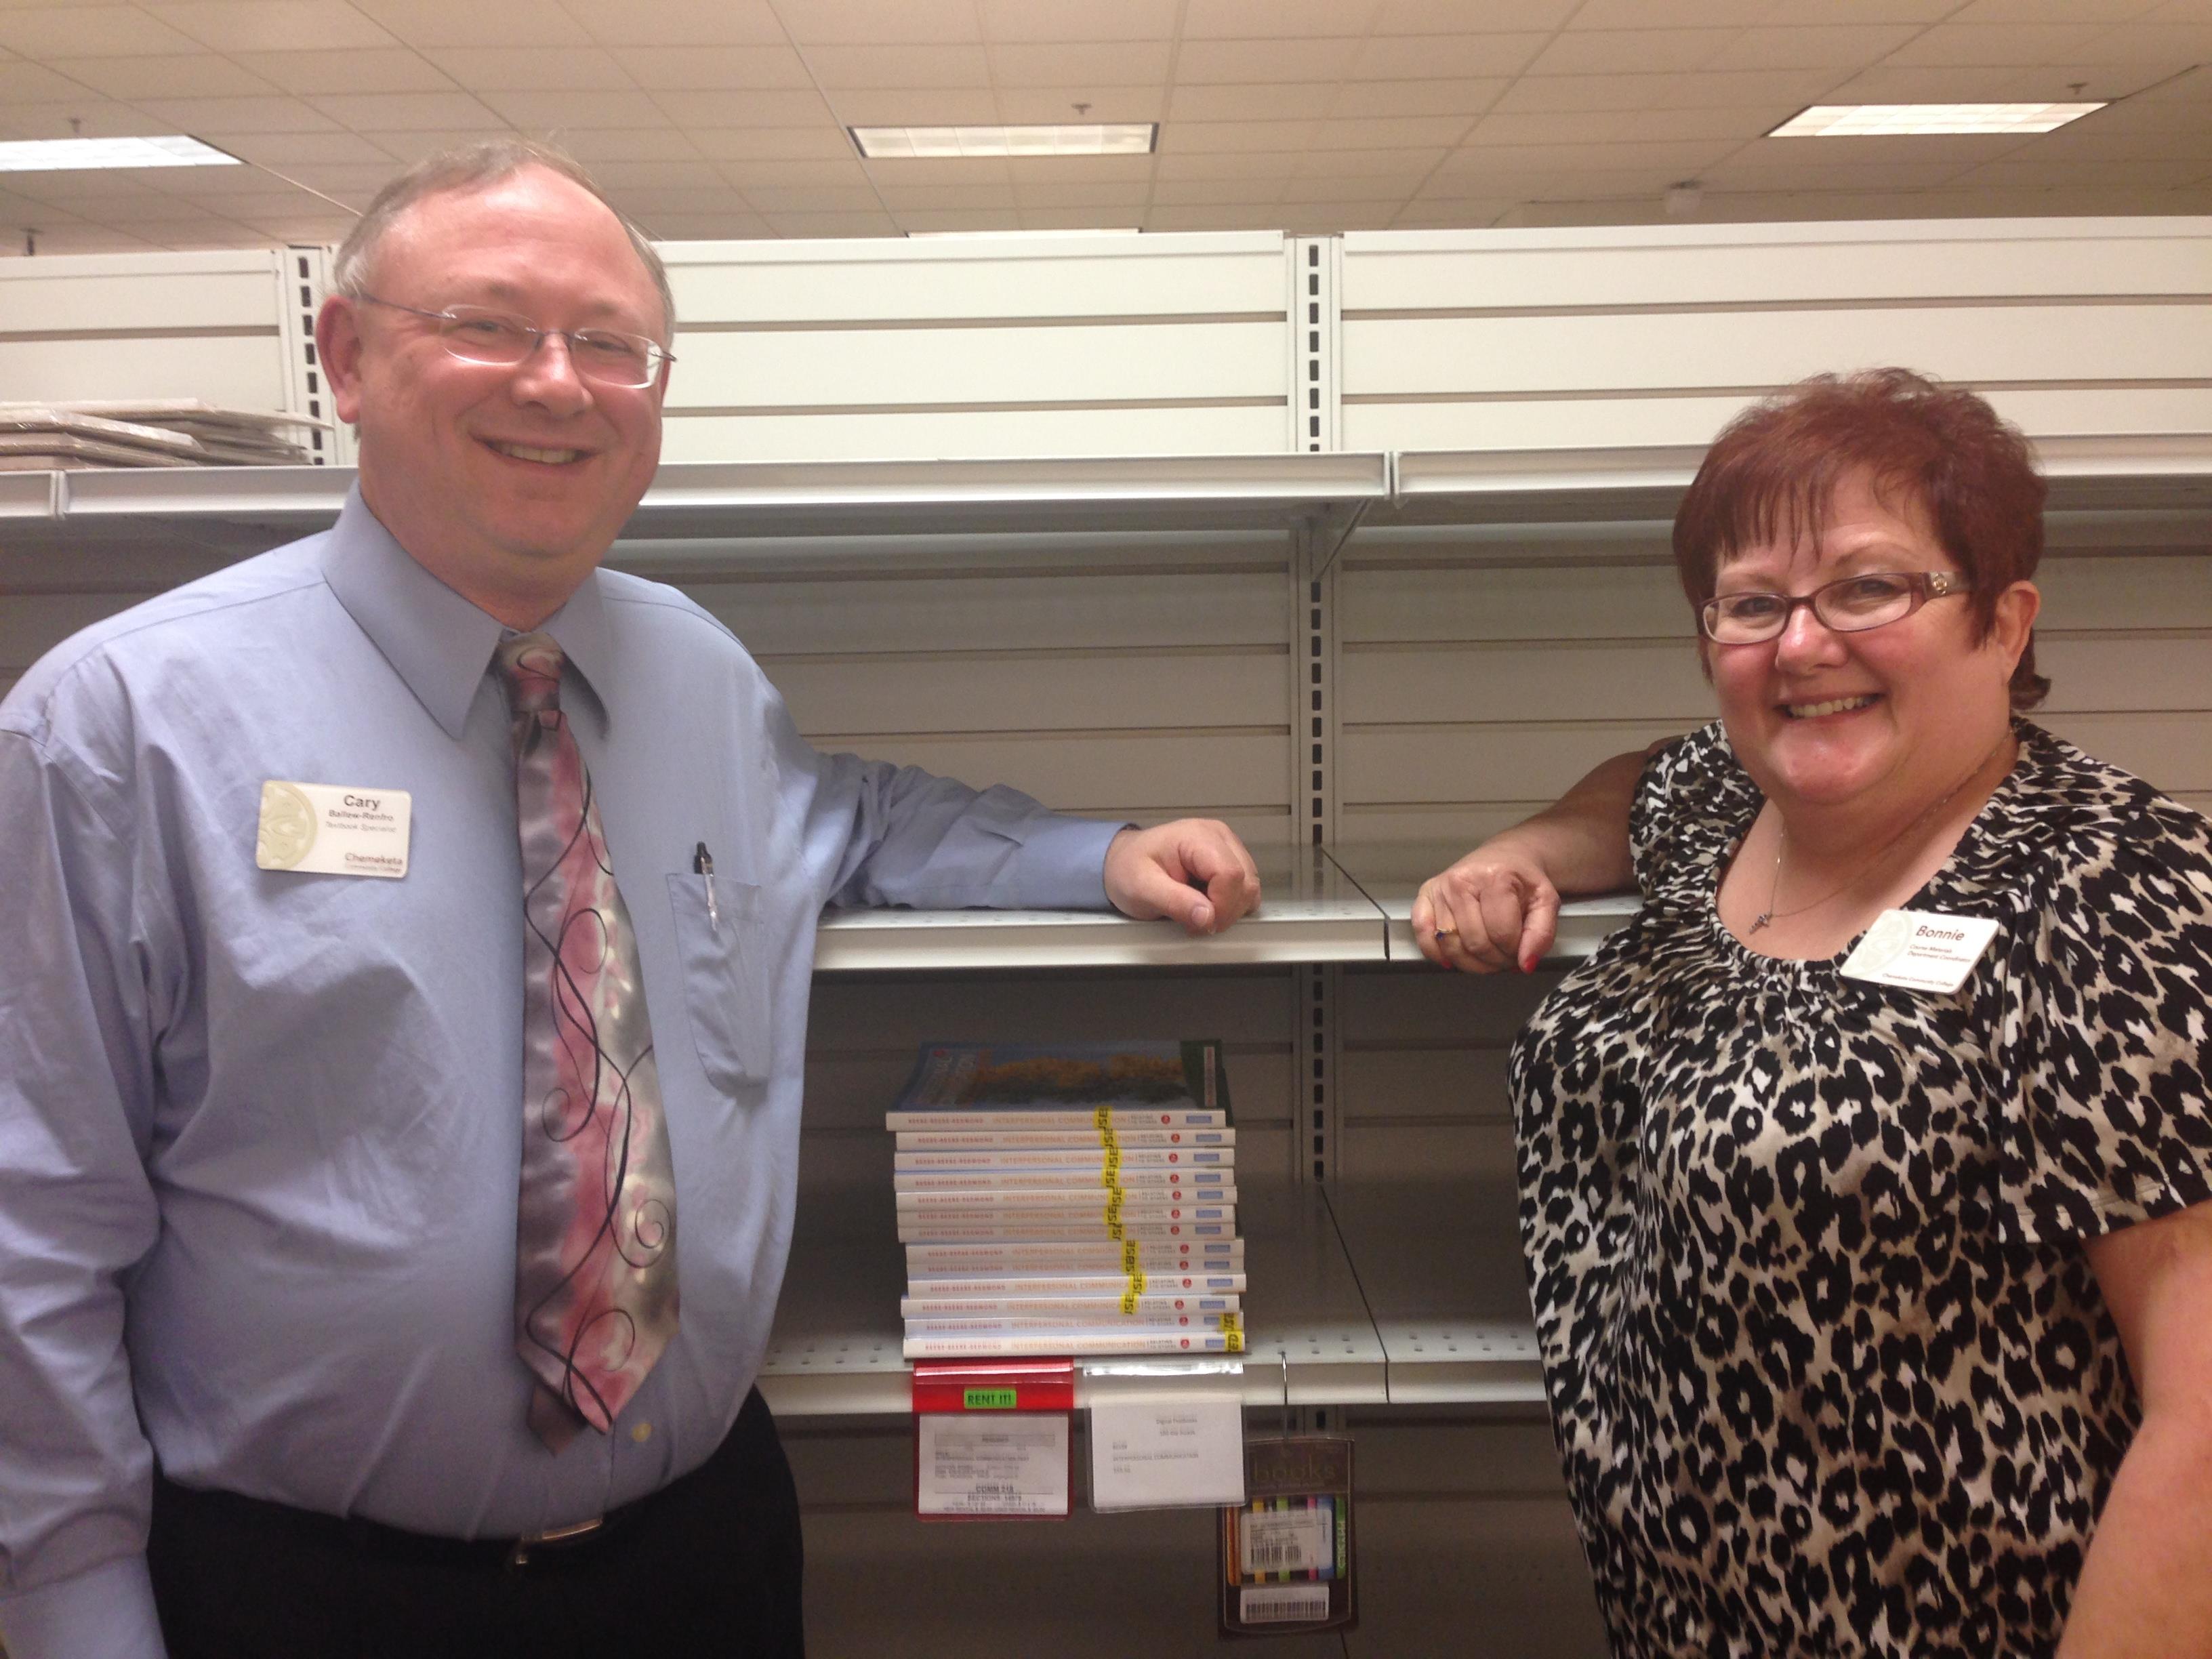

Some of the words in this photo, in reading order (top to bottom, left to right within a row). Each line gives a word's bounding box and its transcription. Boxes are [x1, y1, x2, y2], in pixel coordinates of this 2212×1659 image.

[344, 794, 381, 811] Cary
[344, 852, 403, 865] Chemeketa
[1916, 924, 1965, 941] Bonnie
[968, 1393, 995, 1405] RENT
[1000, 1394, 1011, 1405] IT!
